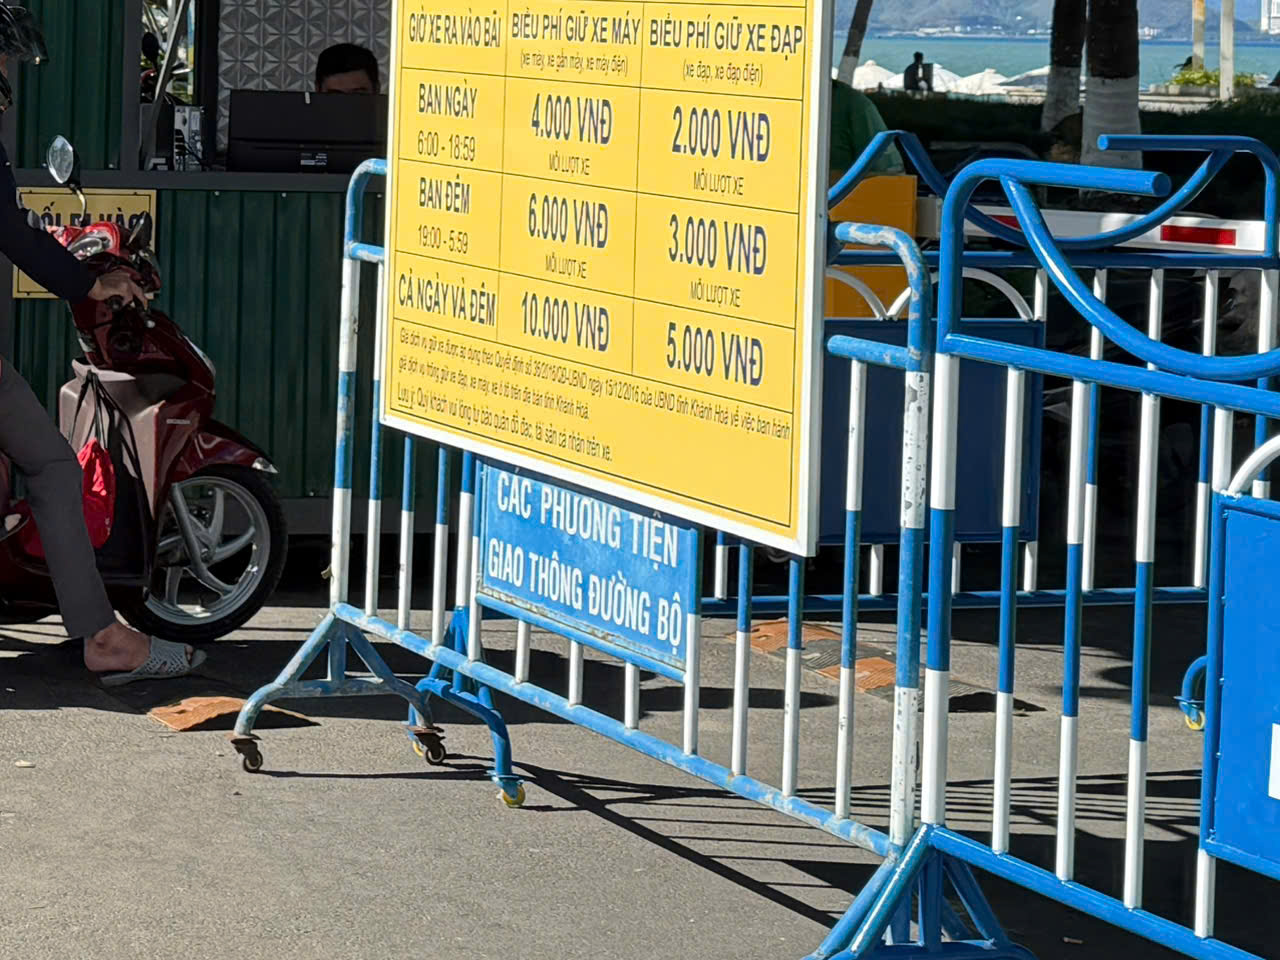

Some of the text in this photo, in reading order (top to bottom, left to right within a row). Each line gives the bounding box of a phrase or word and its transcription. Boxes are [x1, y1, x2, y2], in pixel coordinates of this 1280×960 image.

[408, 4, 501, 48] GIỜ XE RA VÀO BÃI
[511, 6, 641, 47] BIỂU PHÍ GIỮ XE MÁY
[649, 12, 803, 61] BIỂU PHÍ GIỮ XE ĐẠP
[418, 78, 477, 119] BAN NGÀY
[530, 92, 612, 144] 4.000 VNĐ
[417, 129, 439, 157] 6:00
[448, 133, 475, 162] 18:59
[671, 104, 770, 162] 2.000 VNĐ
[418, 175, 470, 214] BAN ĐÊM
[528, 192, 608, 248] 6.000 VNĐ
[417, 223, 441, 249] 19:00
[448, 229, 468, 254] 5:59
[668, 213, 766, 275] 3.000 VNĐ
[398, 267, 496, 326] CẢ NGÀY VÀ ĐÊM
[521, 287, 609, 352] 10.000 VNĐ
[666, 319, 763, 386] 5.000 VNĐ
[497, 467, 679, 571] CÁC PHƯƠNG TIỆN
[488, 538, 682, 655] GIAO THÔNG ĐƯỜNG BỘ
